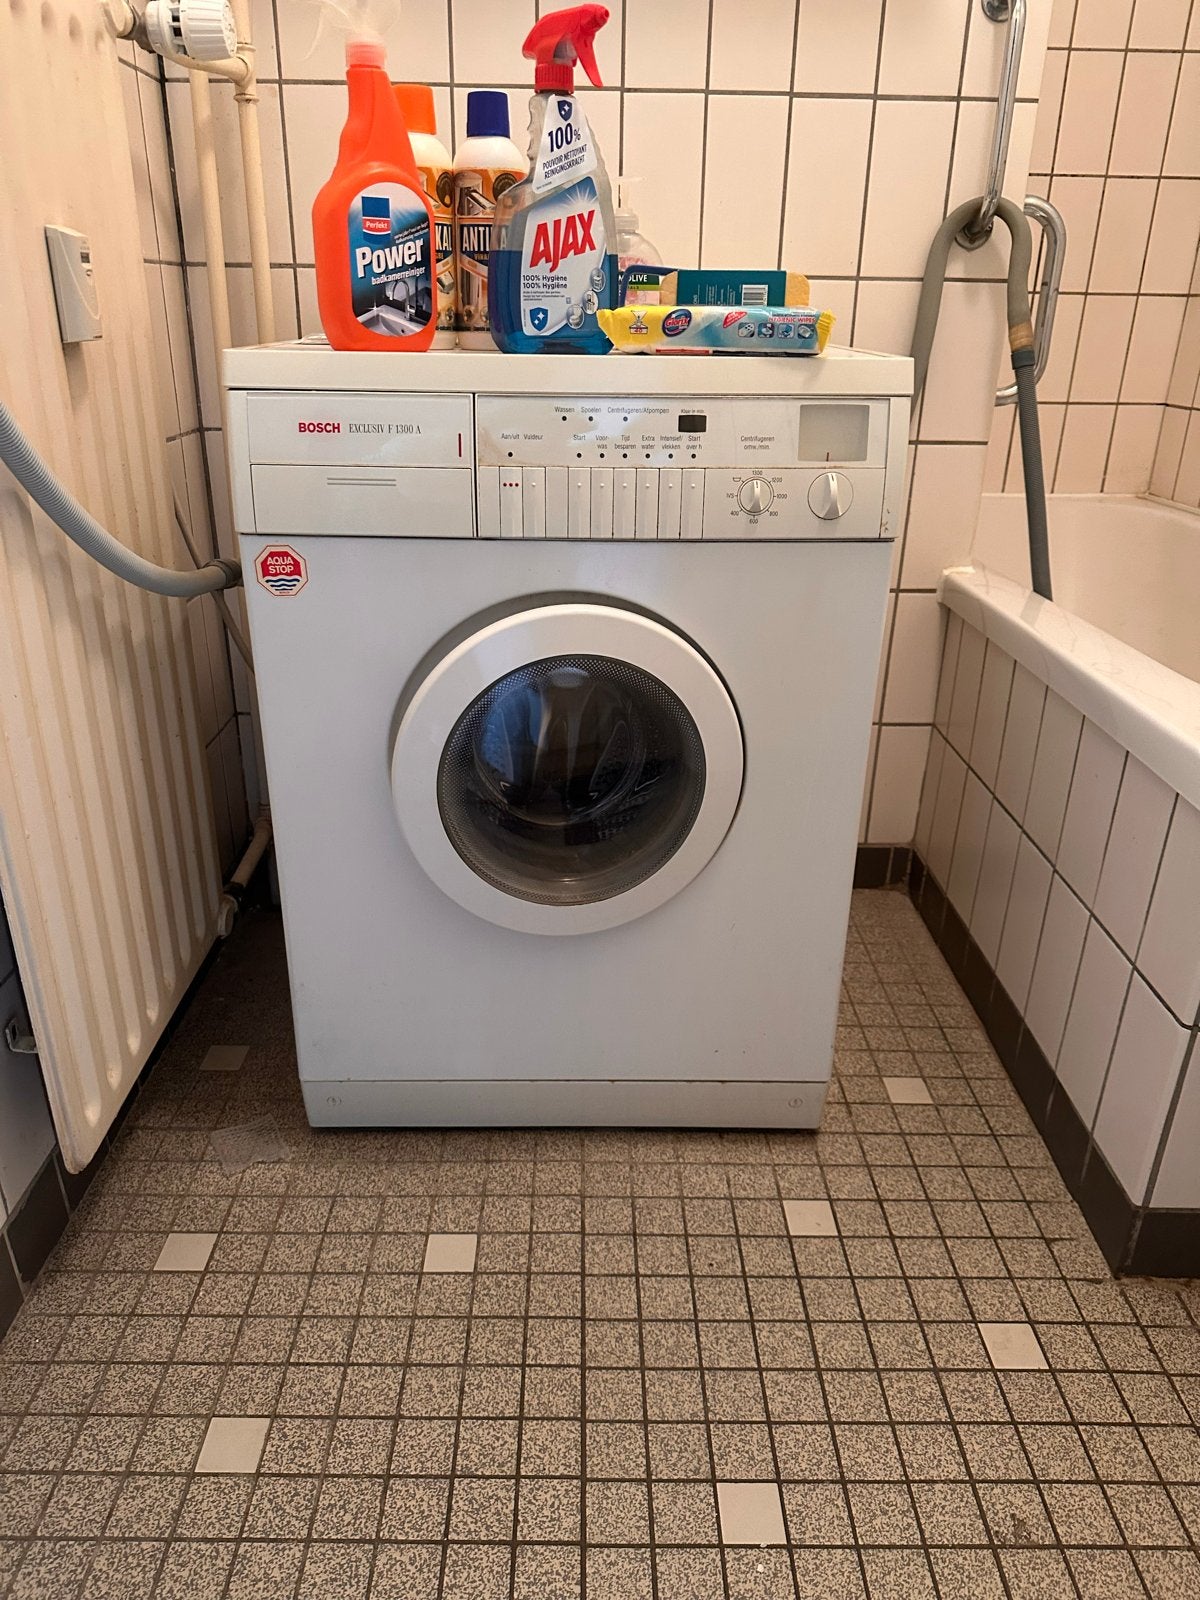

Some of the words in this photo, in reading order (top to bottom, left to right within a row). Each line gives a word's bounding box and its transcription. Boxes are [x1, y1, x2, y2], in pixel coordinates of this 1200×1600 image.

[548, 122, 581, 153] 100%
[542, 154, 563, 170] POUVOIR
[563, 144, 587, 160] NETTOYANT
[544, 154, 585, 180] REINIGINGSKRACHT
[365, 221, 388, 229] Perfekt
[529, 209, 596, 273] AJAX
[355, 238, 424, 278] Power
[371, 266, 425, 285] badkamerreiniger
[522, 274, 541, 282] 100%
[580, 406, 602, 414] Spoelen
[298, 422, 341, 433] BOSCH
[349, 423, 385, 434] EXCLUSIV
[388, 424, 393, 434] F
[395, 424, 414, 434] 1300
[415, 424, 422, 434] A
[621, 434, 630, 442] Tijd
[641, 434, 655, 442] Extra
[740, 435, 775, 443] Centrifugeren
[614, 443, 637, 451] besparen
[267, 556, 294, 565] AQUA
[268, 565, 294, 574] STOP
